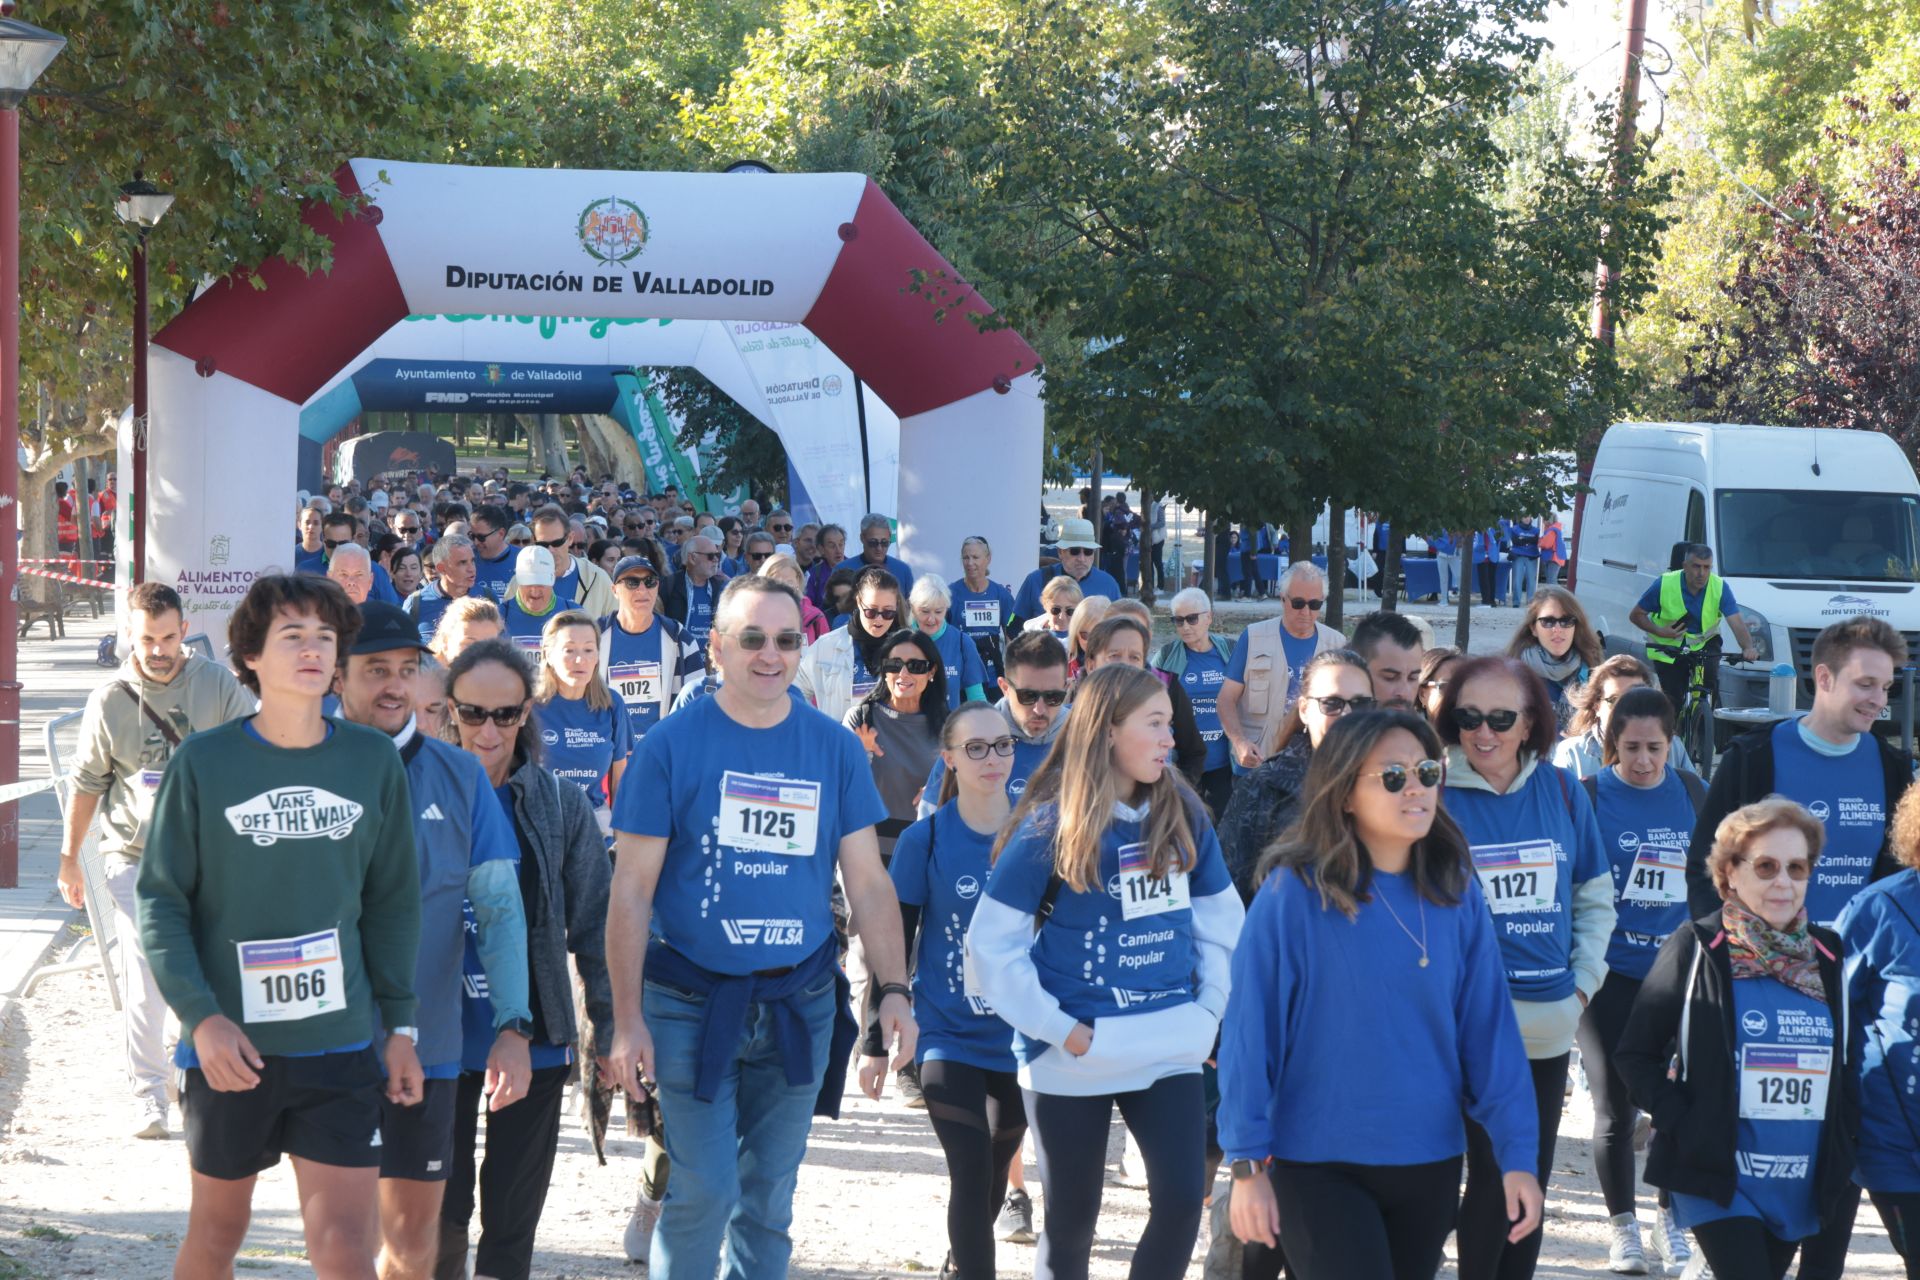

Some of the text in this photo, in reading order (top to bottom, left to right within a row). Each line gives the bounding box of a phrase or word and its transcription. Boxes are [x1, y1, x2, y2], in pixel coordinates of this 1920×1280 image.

[445, 265, 775, 297] DIPUTACIÓN DE VALLADOLID
[395, 368, 582, 381] Ayuntamiento de Valladolid
[425, 392, 469, 403] FMD
[177, 585, 189, 594] DE
[973, 611, 992, 621] 1118
[620, 680, 650, 696] 1072
[553, 768, 598, 778] Caminata
[267, 790, 317, 810] VANS
[1839, 803, 1880, 812] BANCO DE
[274, 809, 309, 832] THE
[739, 807, 796, 839] 1125
[1840, 812, 1886, 821] ALIMENTOS
[1648, 831, 1689, 841] BANCO DE
[734, 861, 789, 878] Popular
[1126, 871, 1172, 903] 1124
[1490, 871, 1537, 899] 1127
[1633, 868, 1665, 891] 411
[1818, 873, 1864, 887] Popular
[764, 928, 804, 945] ULSA
[1506, 920, 1555, 937] Popular
[1118, 928, 1175, 948] Caminata
[1118, 950, 1165, 970] Popular
[260, 968, 326, 1004] 1066
[1777, 1015, 1828, 1027] BANCO DE
[1778, 1026, 1834, 1038] ALIMENTOS
[1757, 1077, 1813, 1105] 1296
[1769, 1162, 1809, 1179] ULSA
